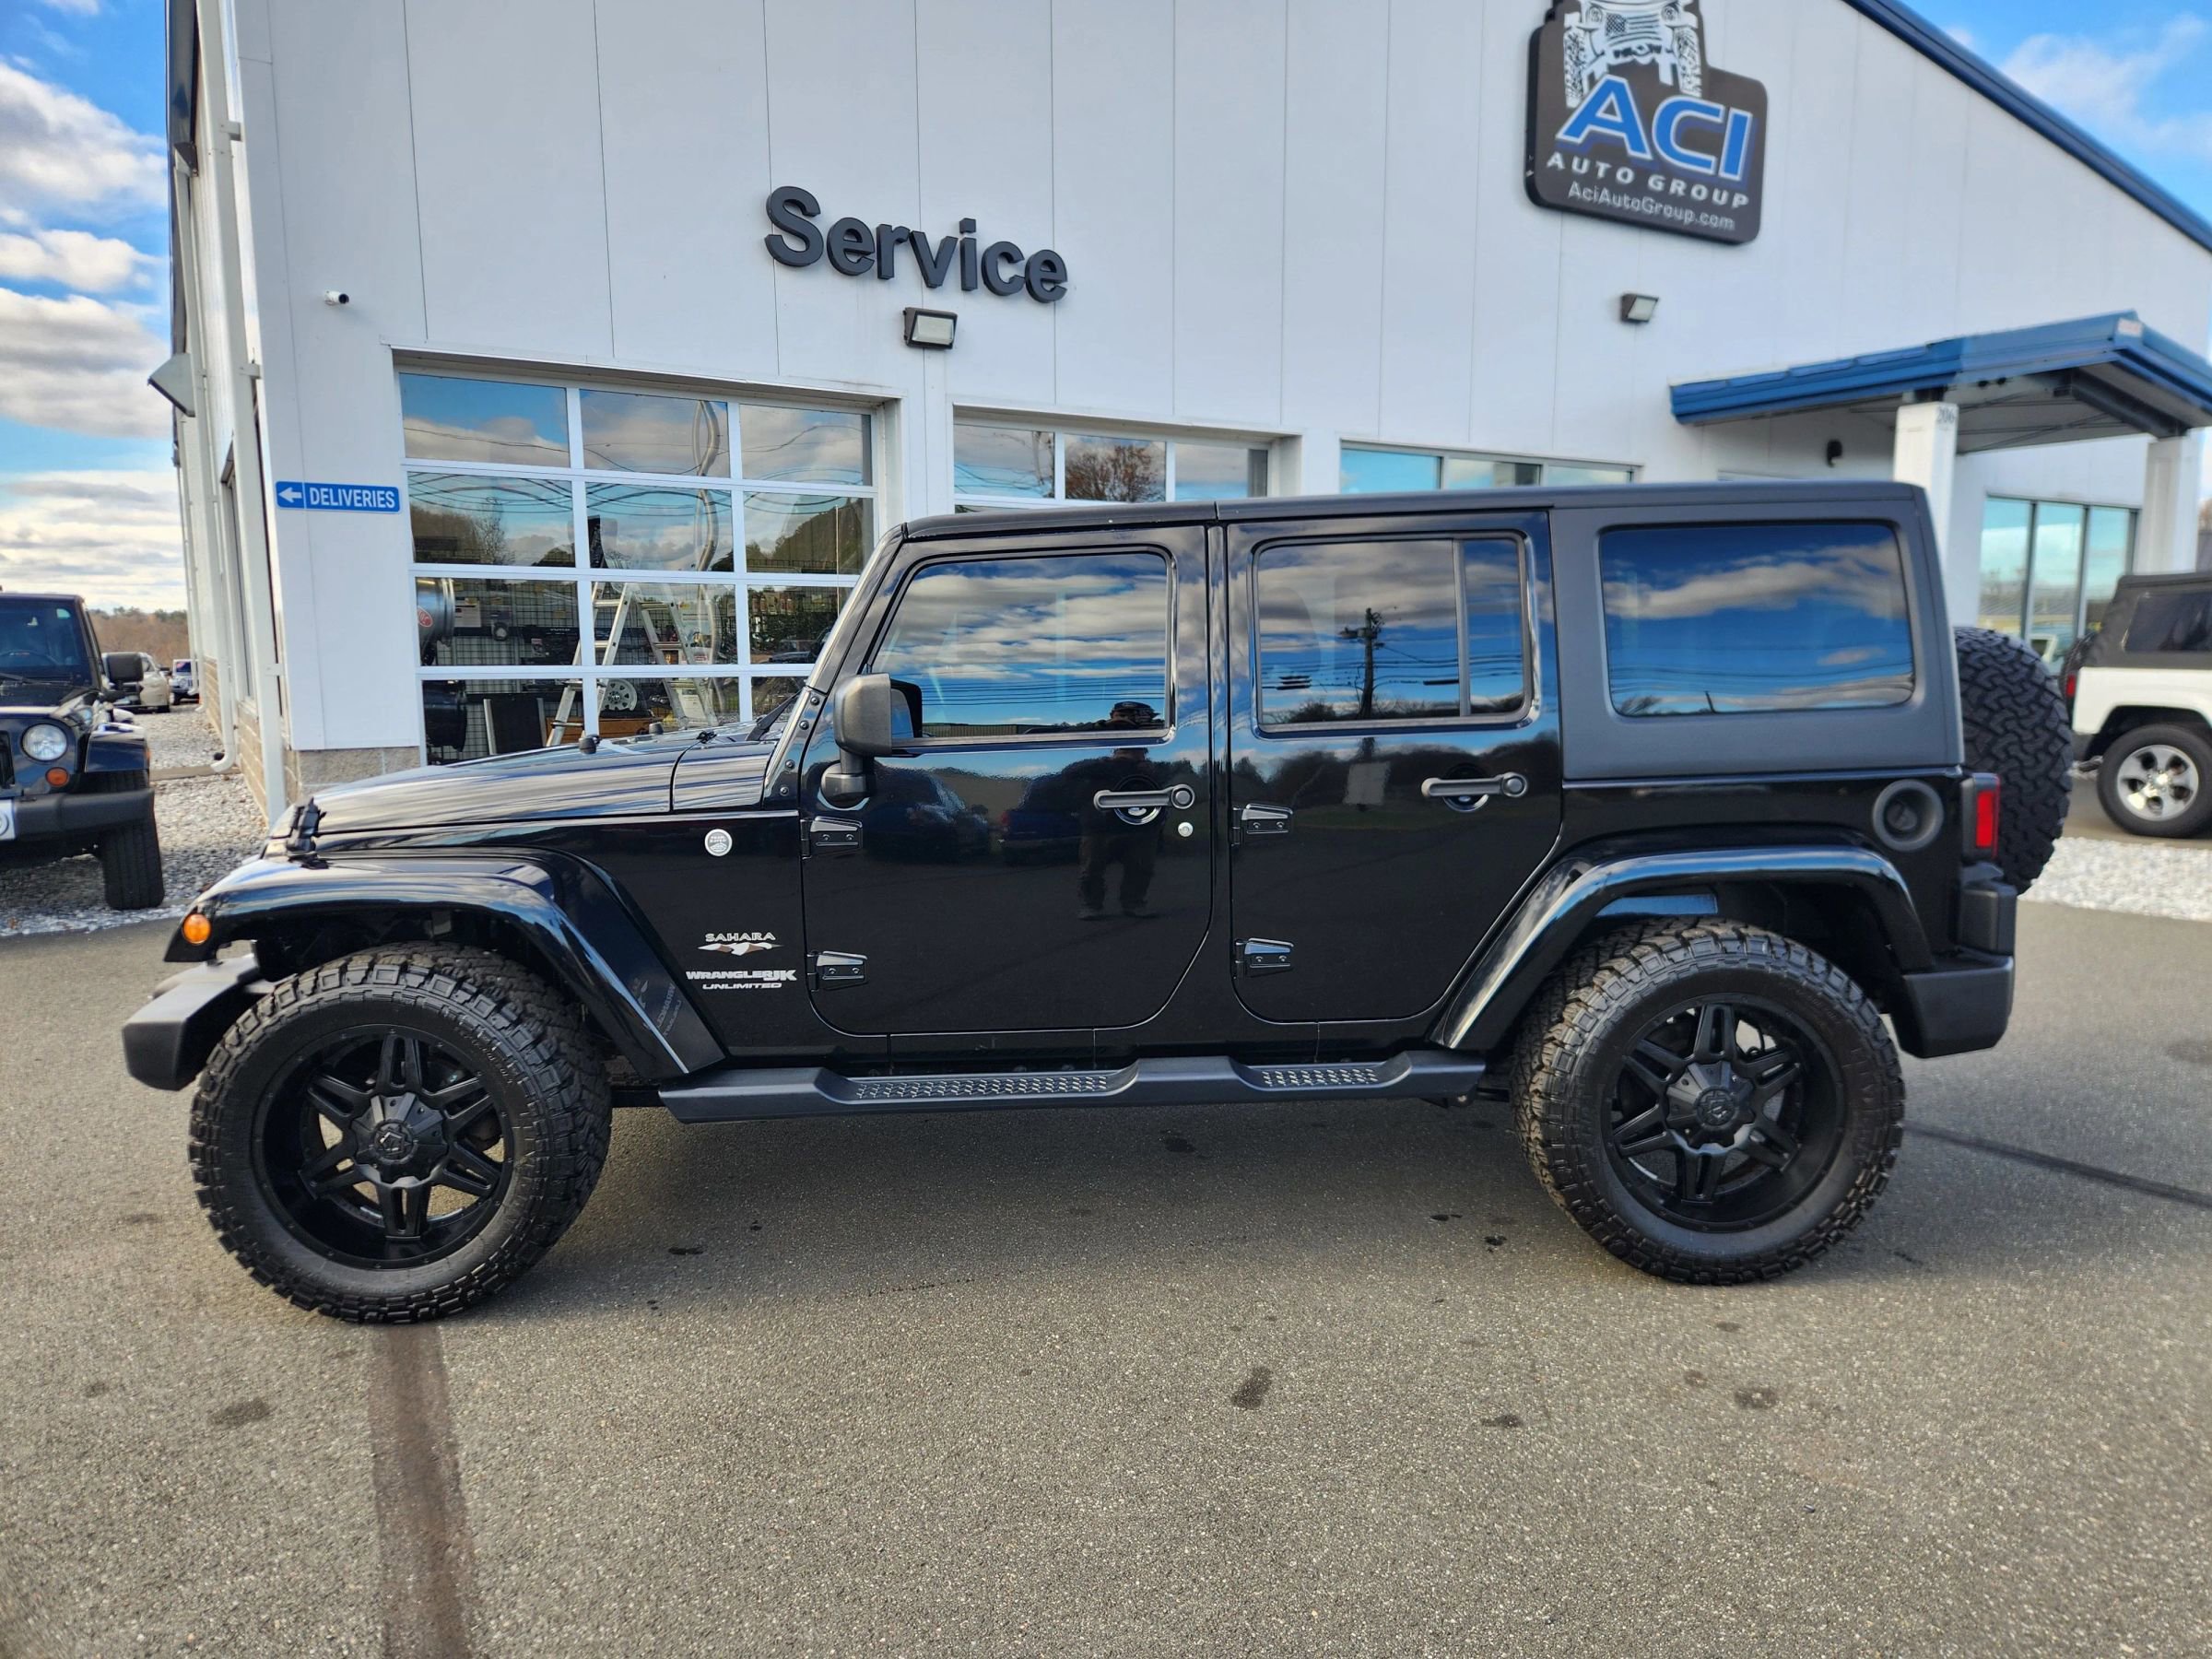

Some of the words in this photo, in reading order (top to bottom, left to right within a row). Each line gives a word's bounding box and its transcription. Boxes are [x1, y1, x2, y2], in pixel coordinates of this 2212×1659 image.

[1555, 74, 1753, 182] ACI
[1547, 150, 1636, 185] AUTO
[1647, 174, 1749, 208] GROUP
[1567, 181, 1735, 230] AciAutoGroup.com
[764, 185, 1068, 303] Service
[309, 487, 395, 509] DELIVERIES
[705, 932, 776, 942] SAHARA
